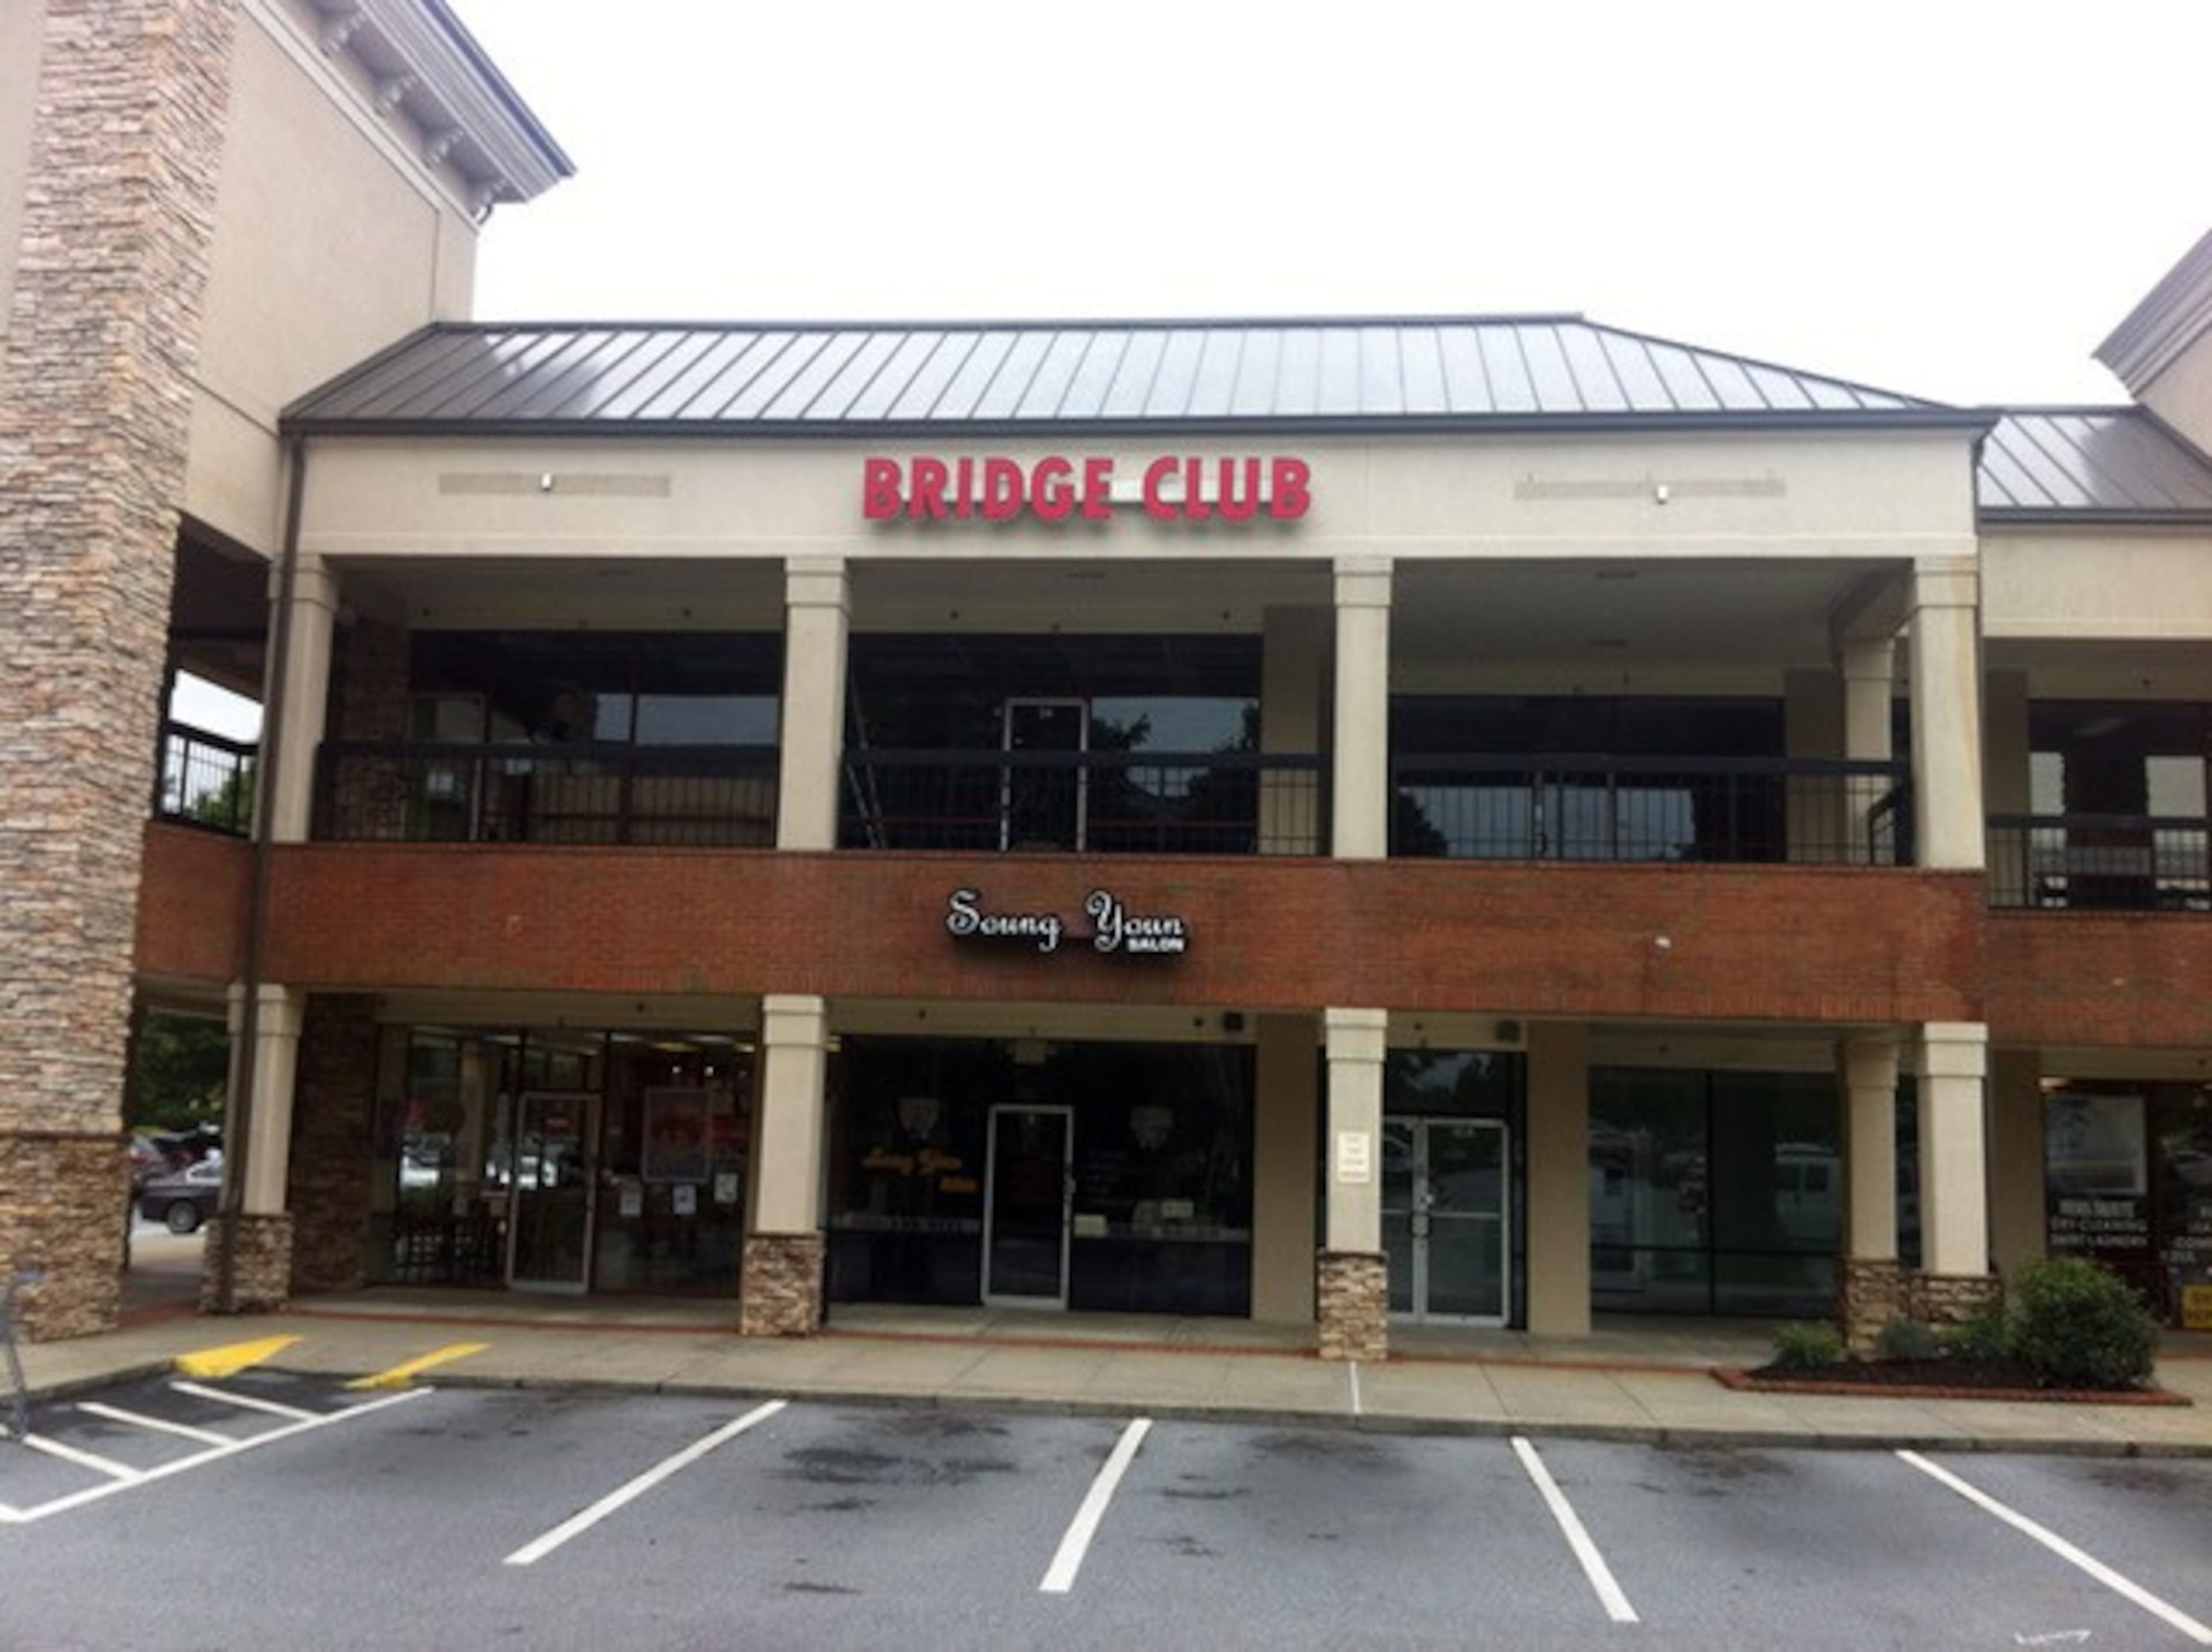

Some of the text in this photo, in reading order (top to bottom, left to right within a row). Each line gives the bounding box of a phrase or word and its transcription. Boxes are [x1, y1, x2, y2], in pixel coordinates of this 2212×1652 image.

[862, 455, 1311, 521] BRIDGE CLUB
[1127, 937, 1185, 953] SALON
